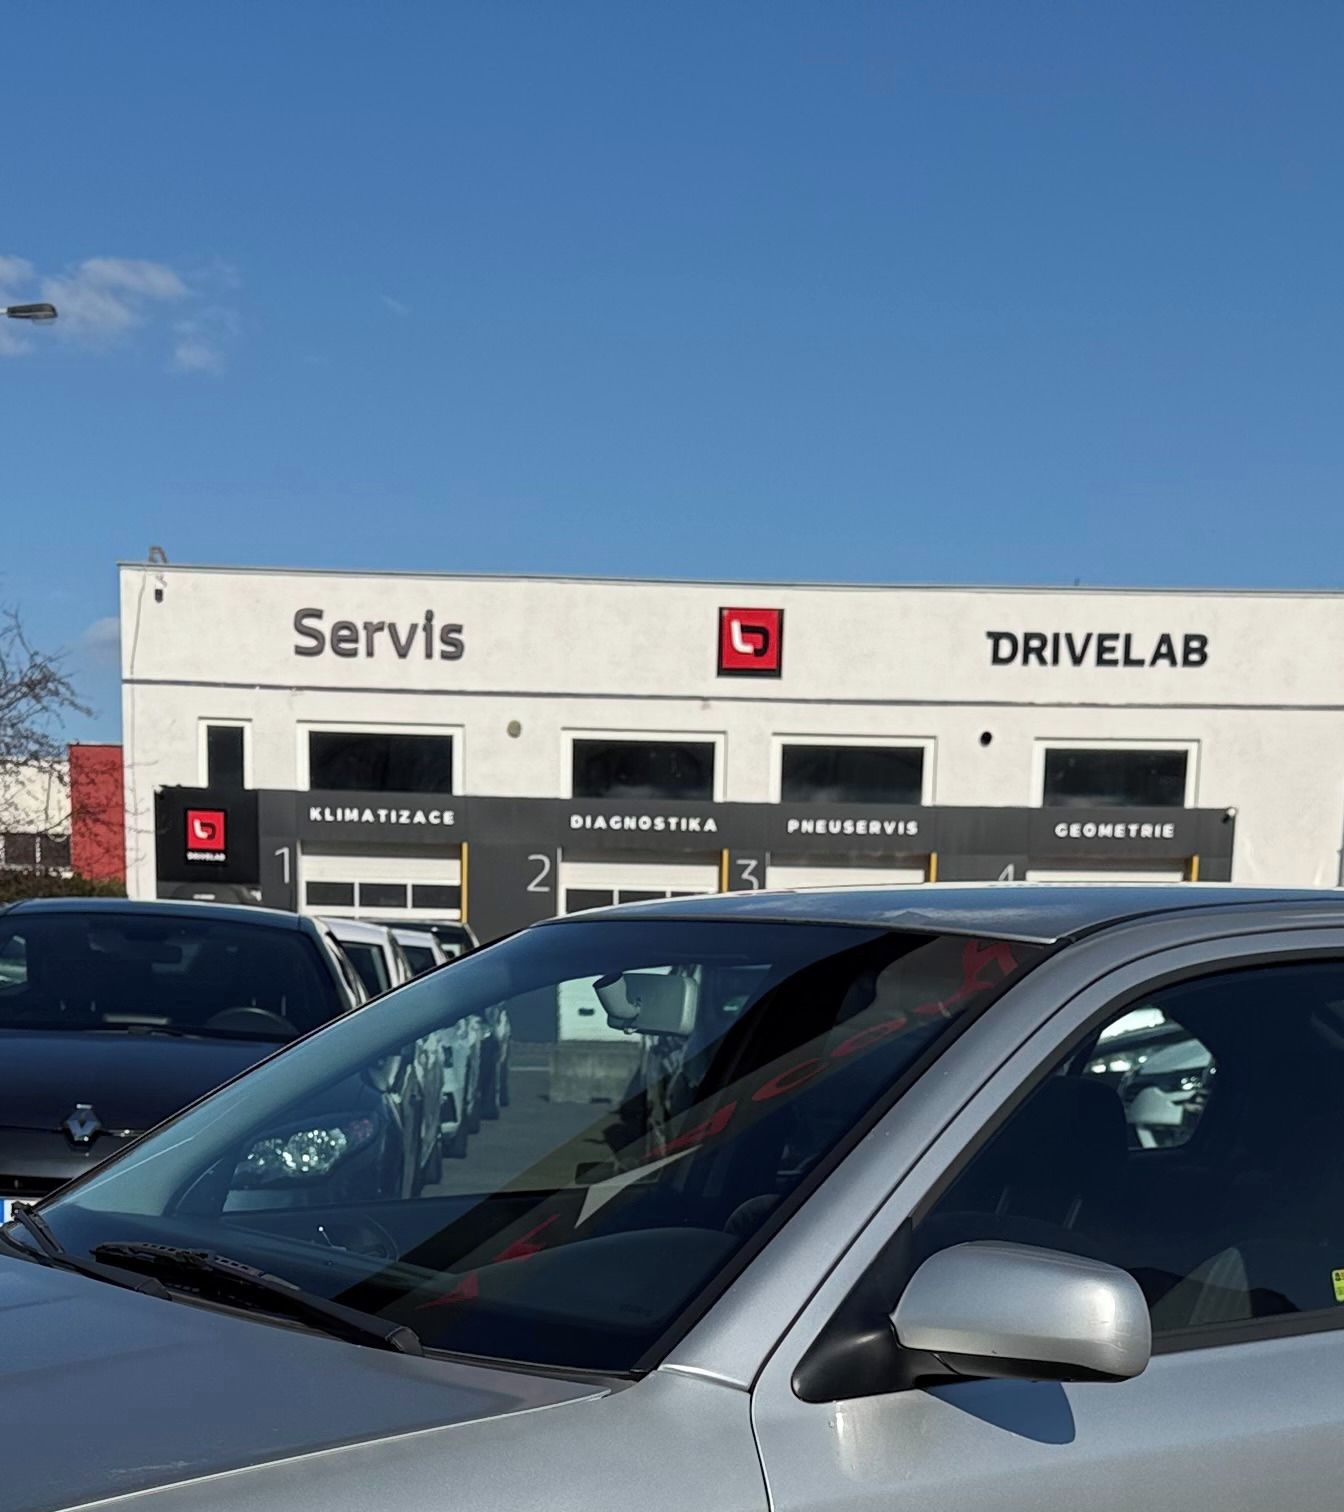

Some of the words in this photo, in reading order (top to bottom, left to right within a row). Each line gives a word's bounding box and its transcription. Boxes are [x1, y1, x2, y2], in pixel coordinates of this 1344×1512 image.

[293, 607, 465, 661] Servis
[985, 630, 1209, 668] DRIVELAB
[309, 806, 455, 826] KLIMATIZACE
[569, 814, 718, 832] DIAGNOSTIKA
[787, 818, 919, 836] PNEUSERVIS
[1054, 822, 1175, 838] GEOMETRIE
[274, 847, 290, 884] 1
[526, 853, 551, 892] 2
[736, 859, 760, 889] 3
